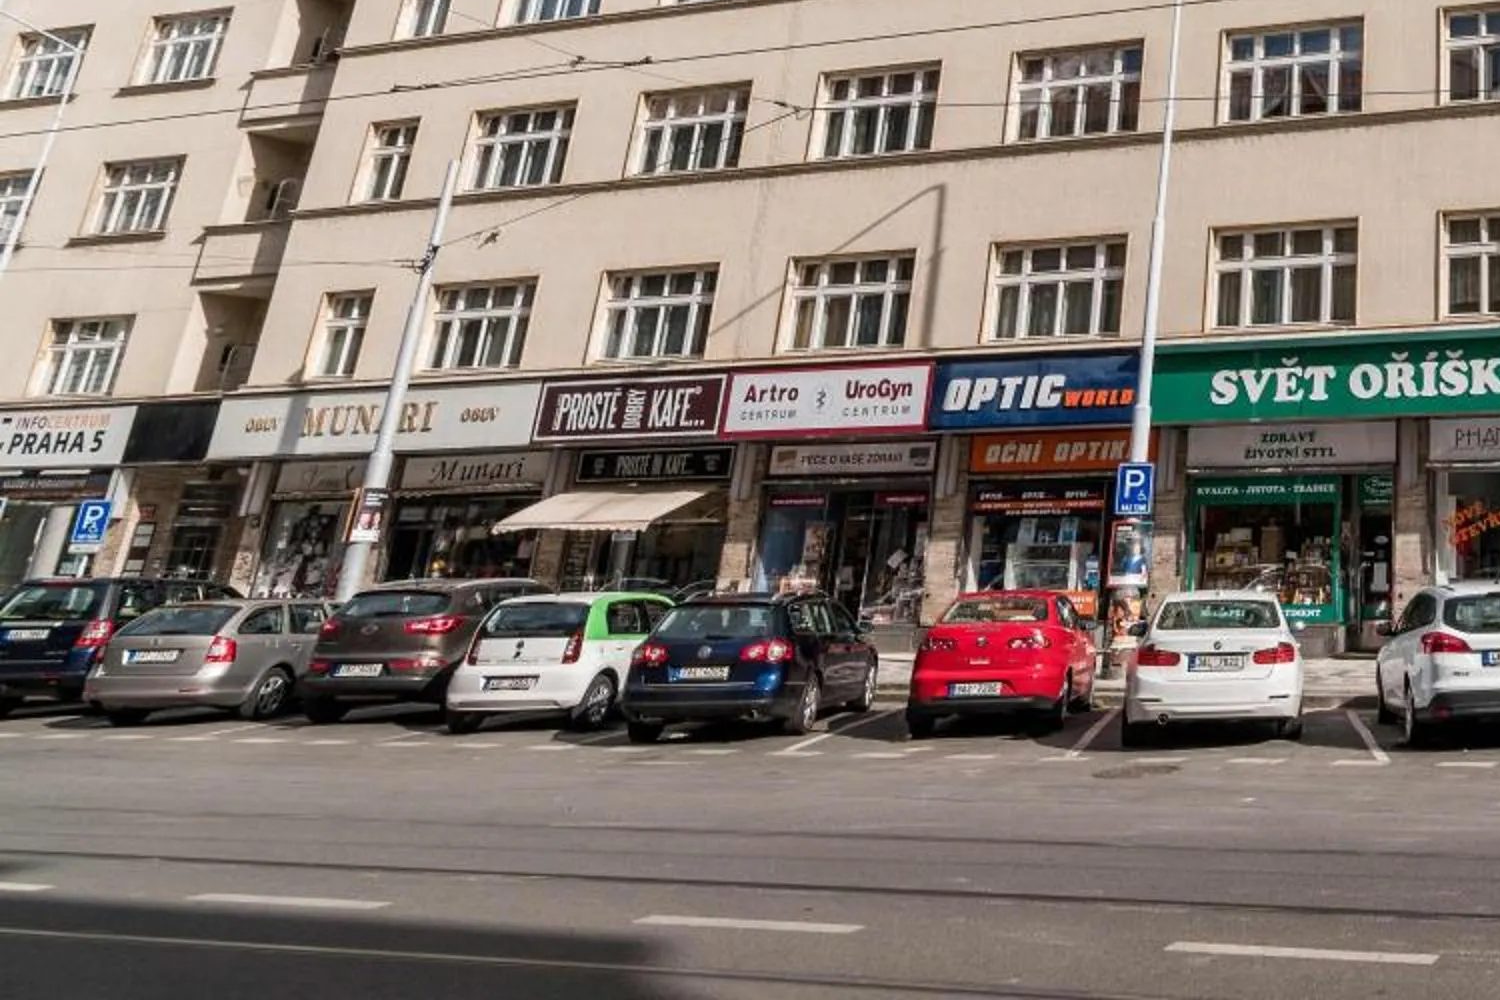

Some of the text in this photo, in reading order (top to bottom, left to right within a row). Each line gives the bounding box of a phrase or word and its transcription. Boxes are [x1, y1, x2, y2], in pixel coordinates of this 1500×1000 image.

[743, 383, 799, 403] Artro
[845, 378, 913, 402] UroGyn
[943, 374, 1136, 411] OPTIC WORLD
[1210, 356, 1336, 405] SVĚT
[300, 401, 438, 437] MUNRI
[740, 409, 797, 422] CENTRUM
[841, 405, 912, 418] CENTRUM
[6, 430, 105, 455] PRAHA 5
[985, 439, 1042, 466] OČNÍ
[430, 457, 526, 482] Munari
[1125, 469, 1146, 499] P
[83, 506, 105, 530] P
